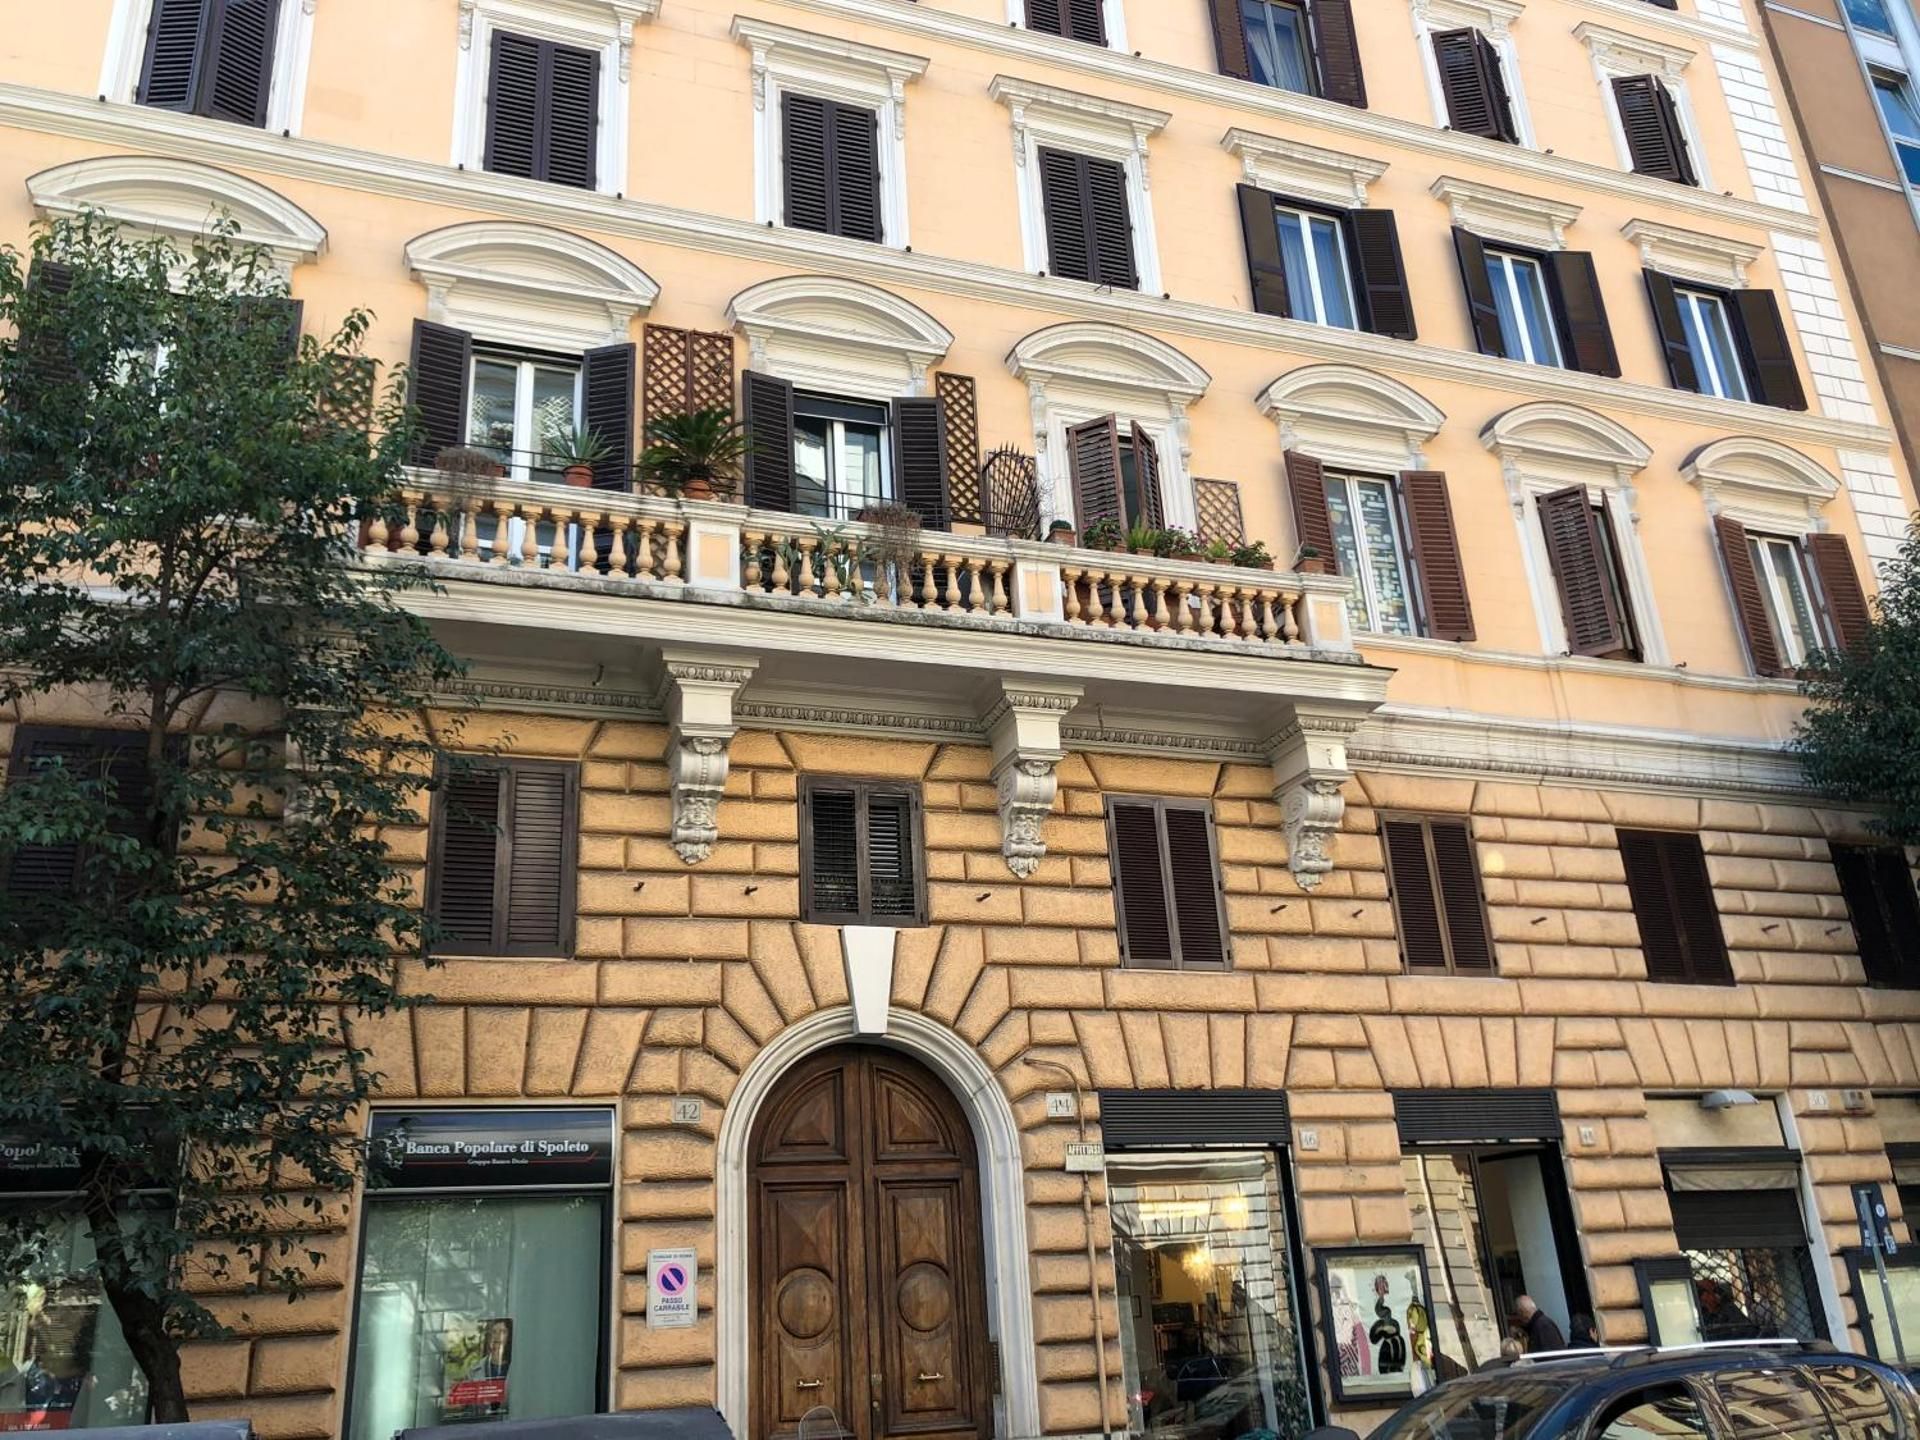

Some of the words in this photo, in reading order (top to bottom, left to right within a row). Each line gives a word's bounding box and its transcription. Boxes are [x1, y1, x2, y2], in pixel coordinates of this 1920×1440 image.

[676, 1103, 698, 1120] 42
[406, 1141, 450, 1154] Banca
[454, 1141, 518, 1157] Popolare
[521, 1140, 535, 1153] di
[538, 1140, 590, 1156] Spoleto
[654, 1304, 690, 1312] CARRABILE
